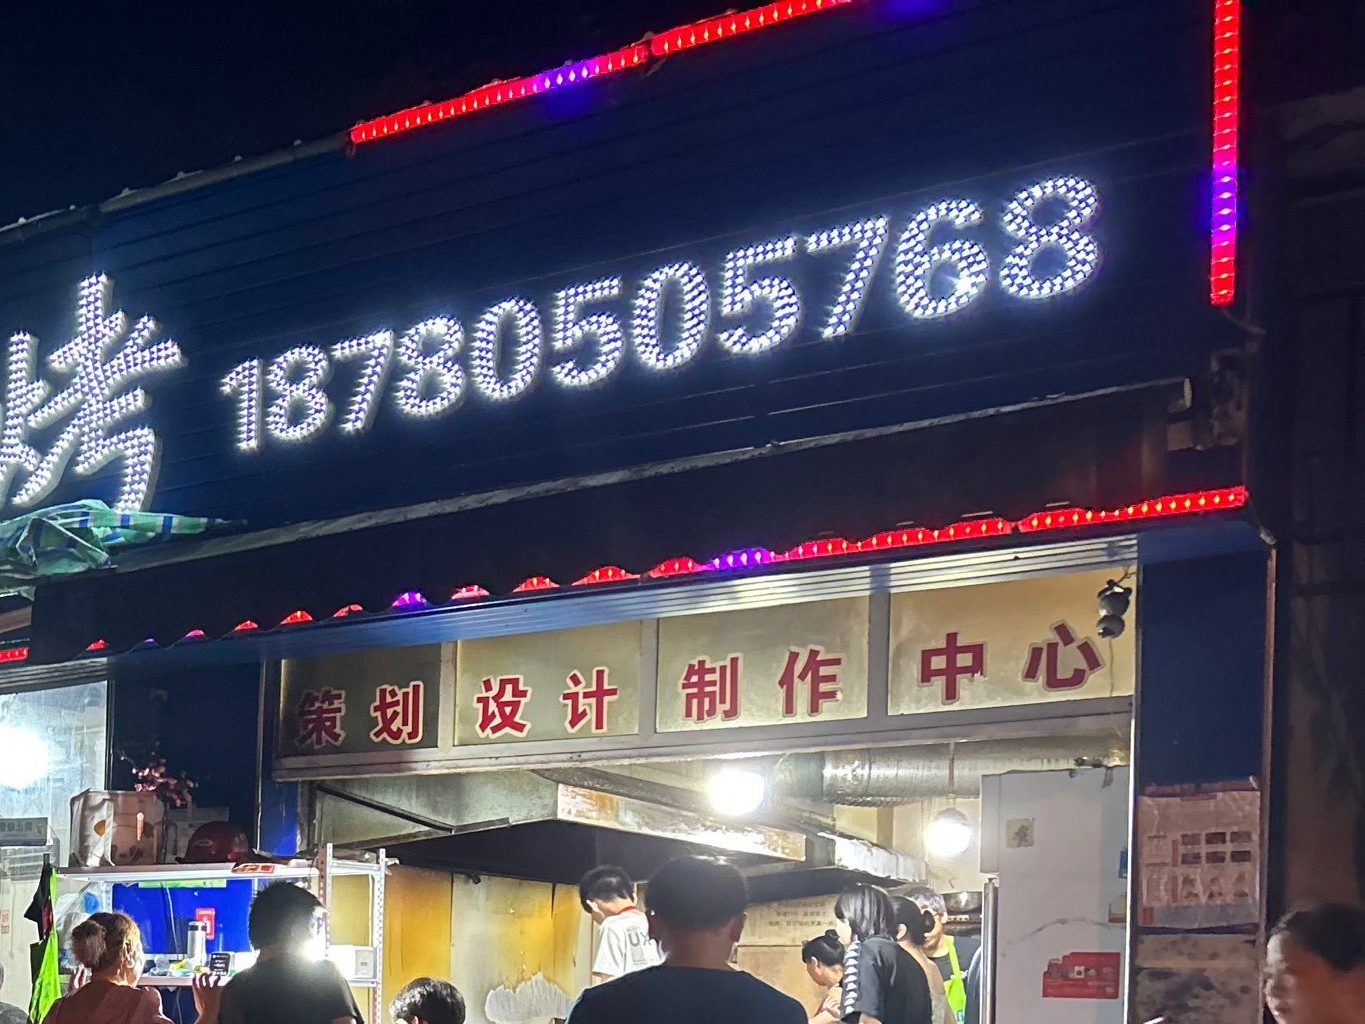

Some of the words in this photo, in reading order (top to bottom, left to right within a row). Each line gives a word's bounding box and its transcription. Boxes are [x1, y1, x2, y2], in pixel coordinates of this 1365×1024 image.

[220, 174, 1099, 451] 18780505768
[297, 621, 1103, 747] 策划设计制作中心
